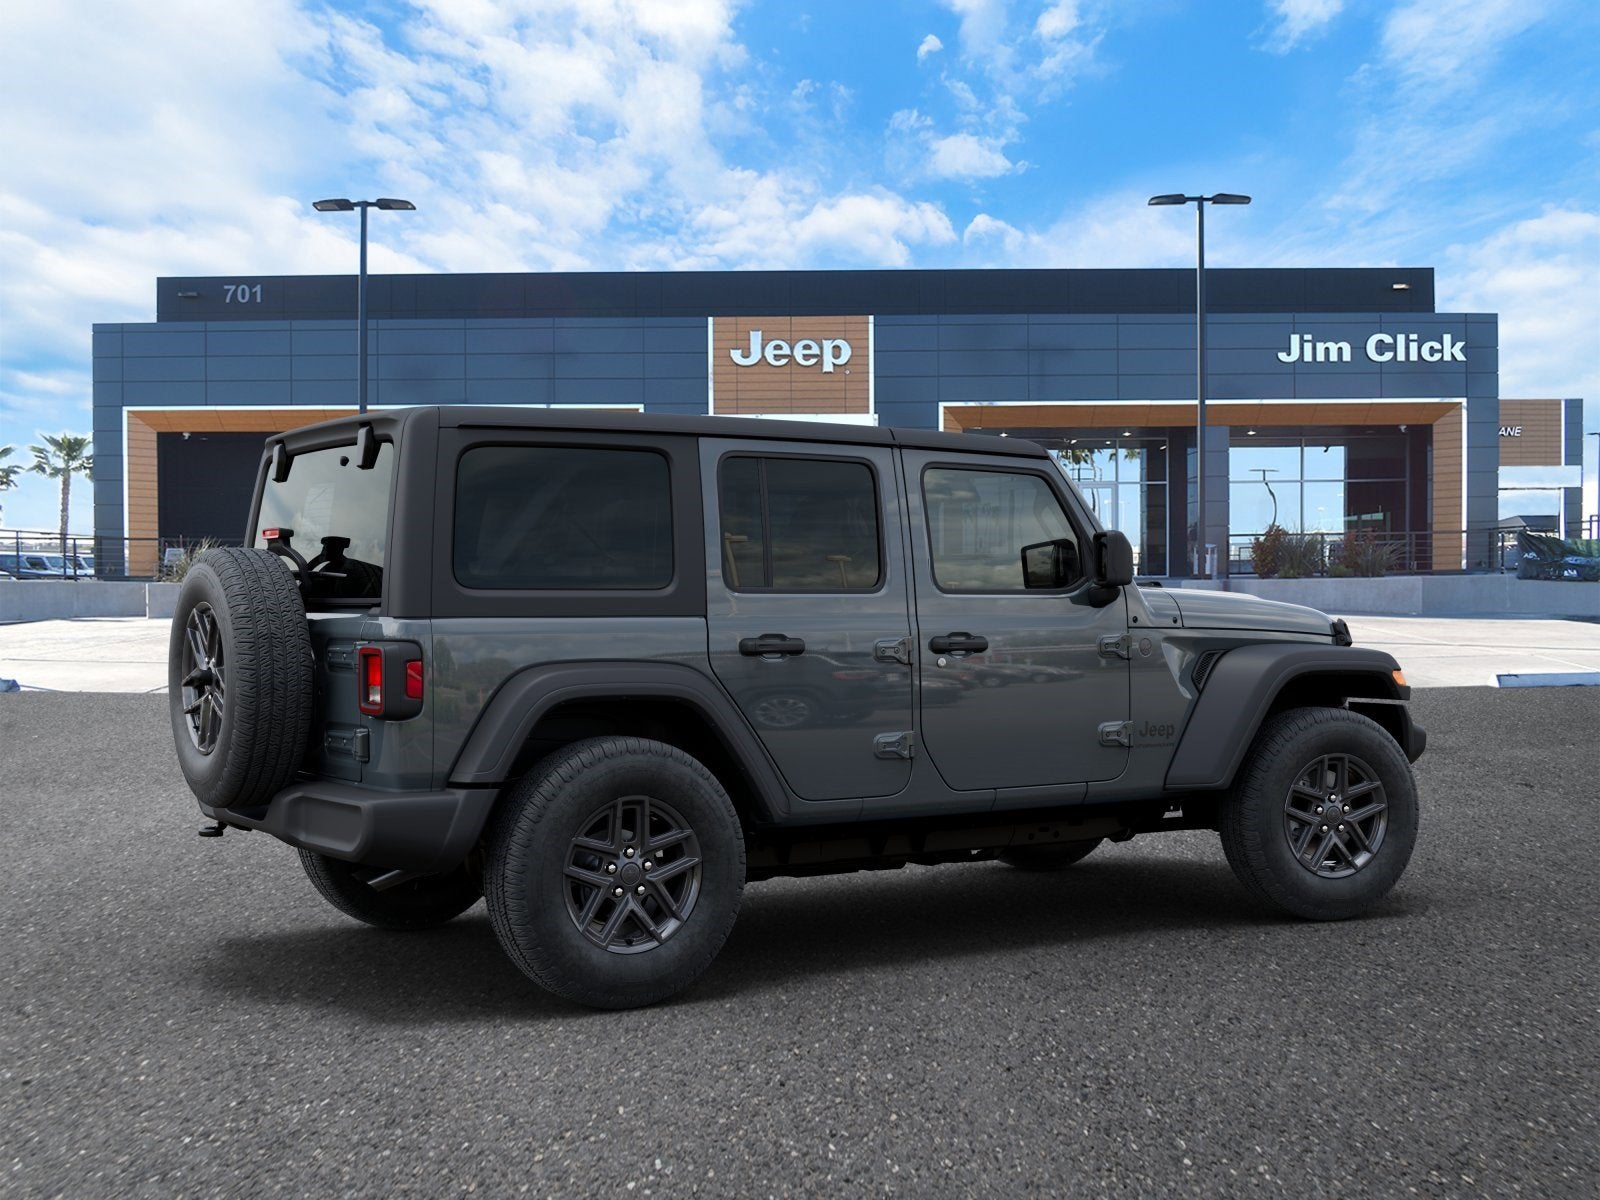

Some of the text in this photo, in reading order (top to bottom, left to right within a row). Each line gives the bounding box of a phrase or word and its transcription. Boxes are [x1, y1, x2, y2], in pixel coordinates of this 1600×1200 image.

[223, 284, 263, 303] 701
[729, 329, 853, 374] Jeep
[1277, 333, 1467, 363] Jim Click
[1138, 720, 1175, 740] Jeep
